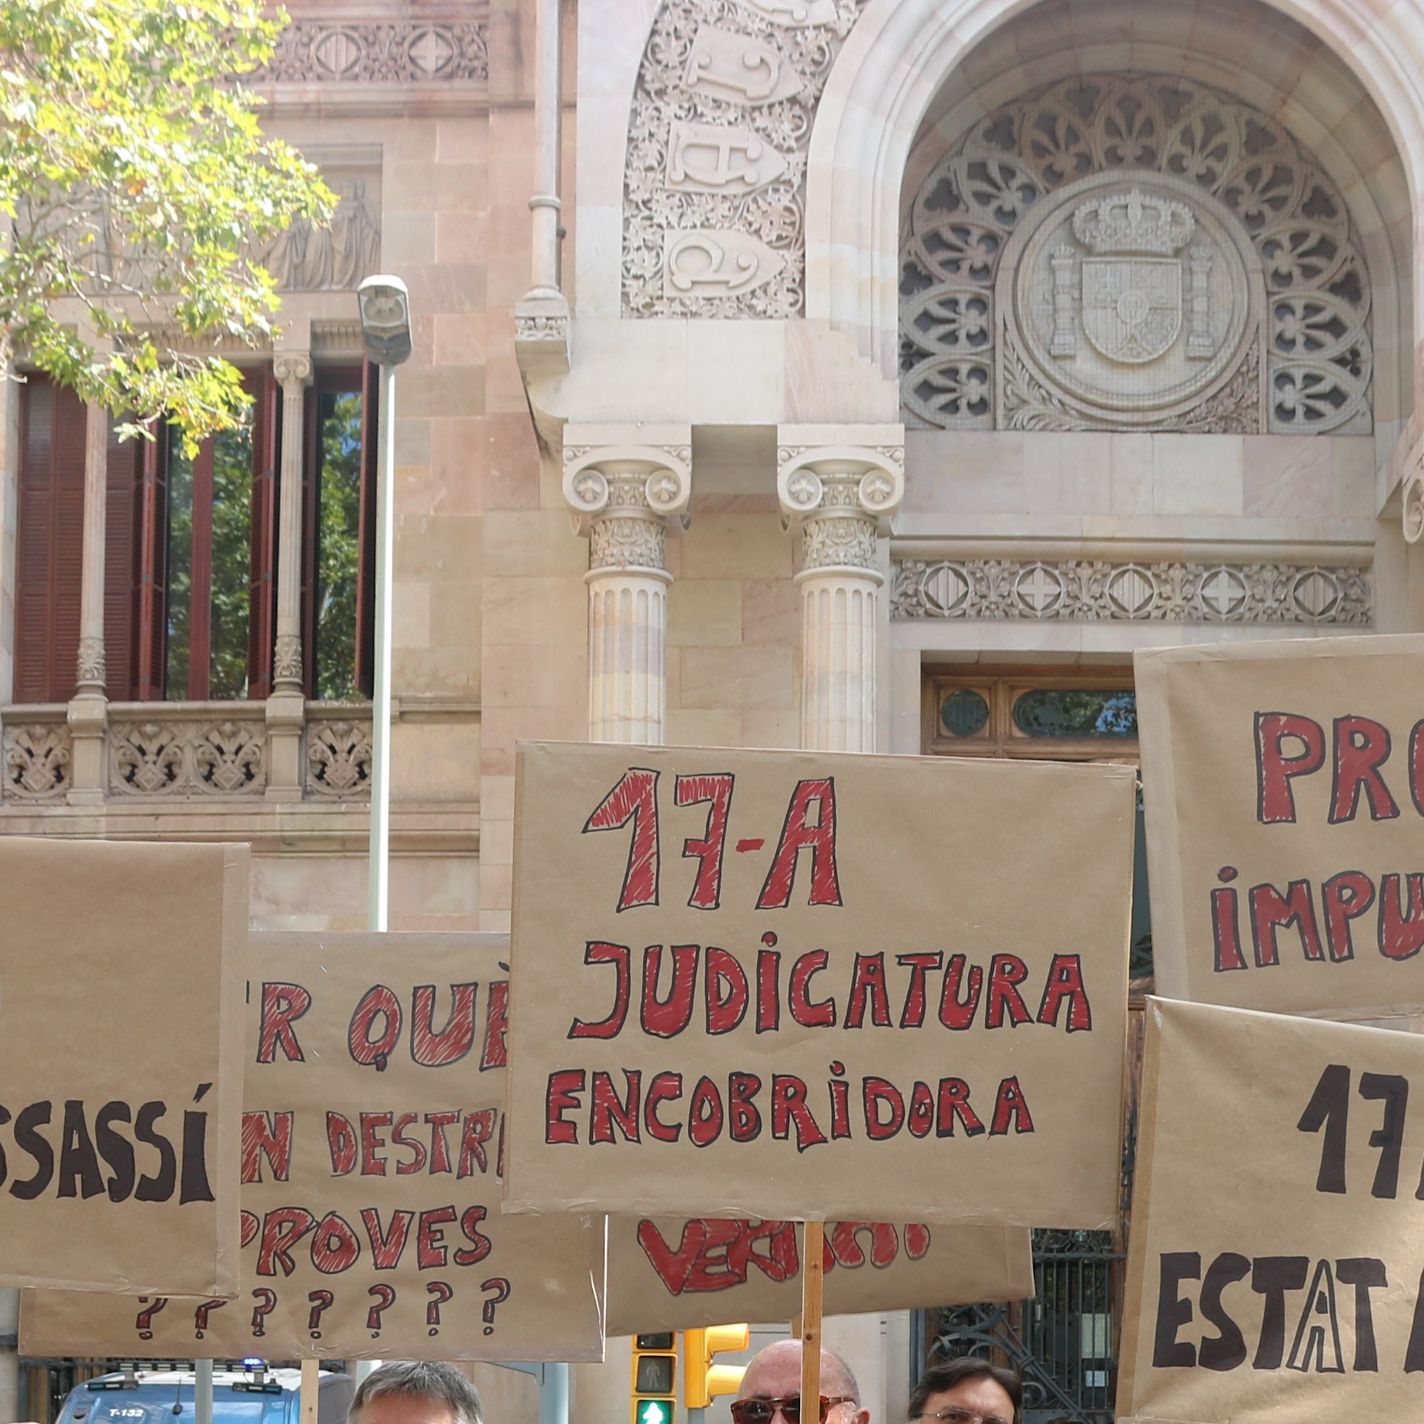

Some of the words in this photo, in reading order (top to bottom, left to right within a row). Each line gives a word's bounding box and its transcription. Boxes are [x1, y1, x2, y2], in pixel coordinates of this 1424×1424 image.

[581, 767, 843, 912] 17-A
[567, 931, 1092, 1039] JUDICATURA
[325, 1107, 506, 1181] DESTR
[545, 1061, 1035, 1152] ENCOBRIDORA
[1297, 1064, 1409, 1200] 17
[1152, 1251, 1388, 1374] ESTAT
